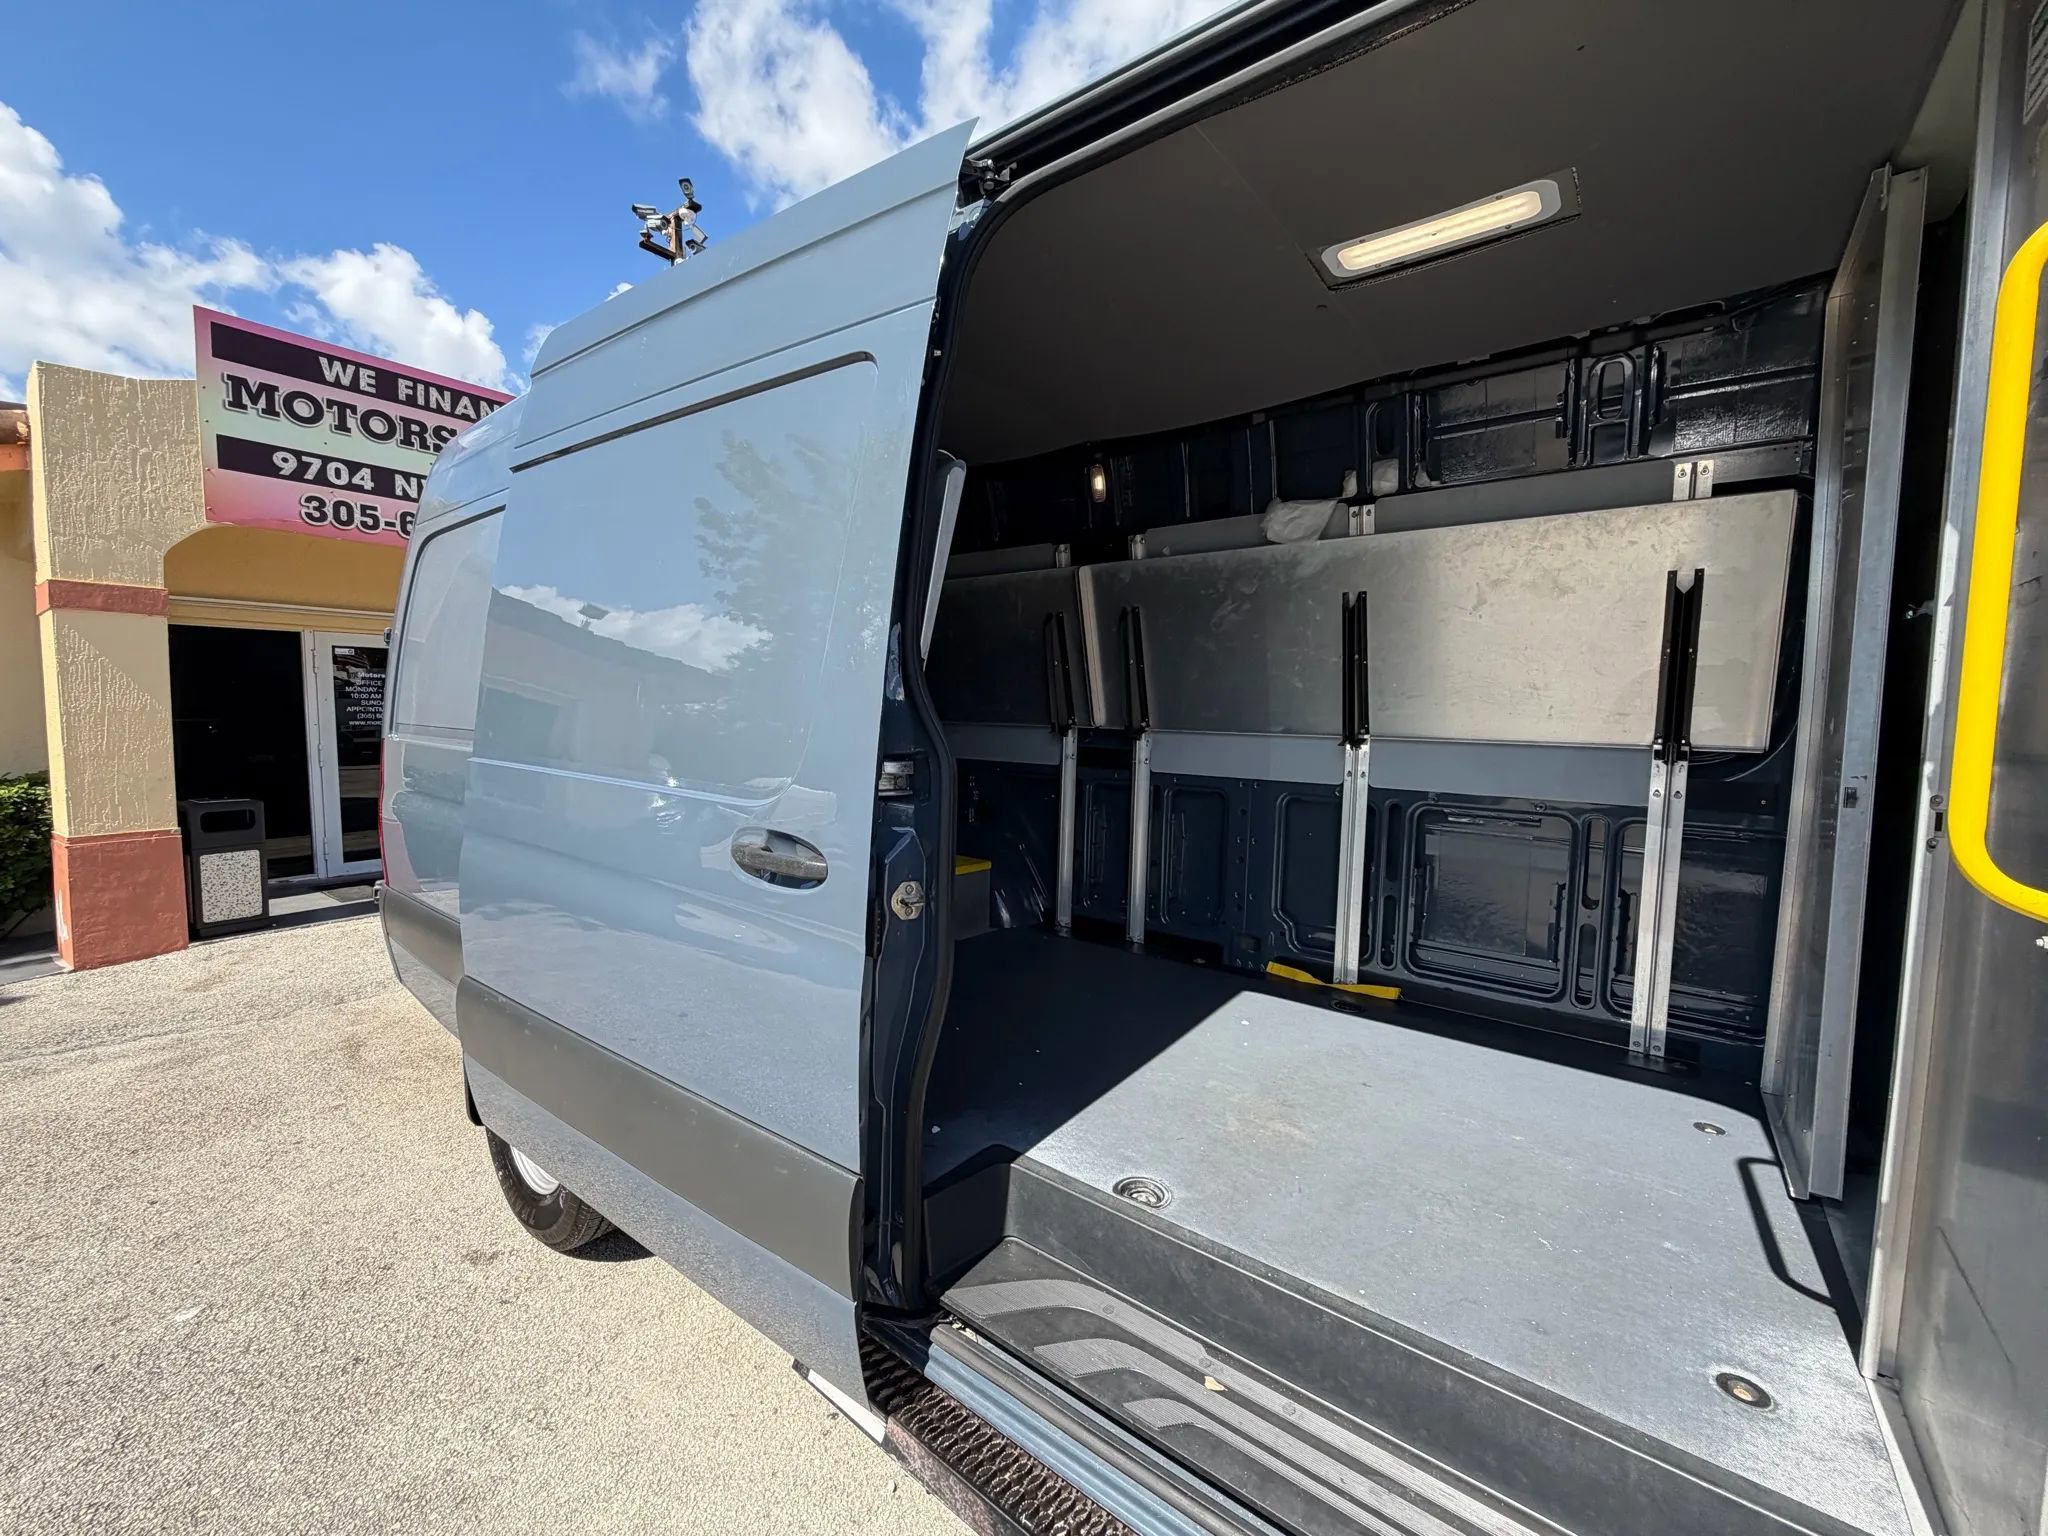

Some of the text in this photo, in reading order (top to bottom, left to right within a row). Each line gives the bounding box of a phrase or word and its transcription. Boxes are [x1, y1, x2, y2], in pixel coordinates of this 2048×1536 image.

[318, 356, 377, 394] WE
[224, 373, 458, 454] MOTORS
[272, 451, 427, 499] 9704 N
